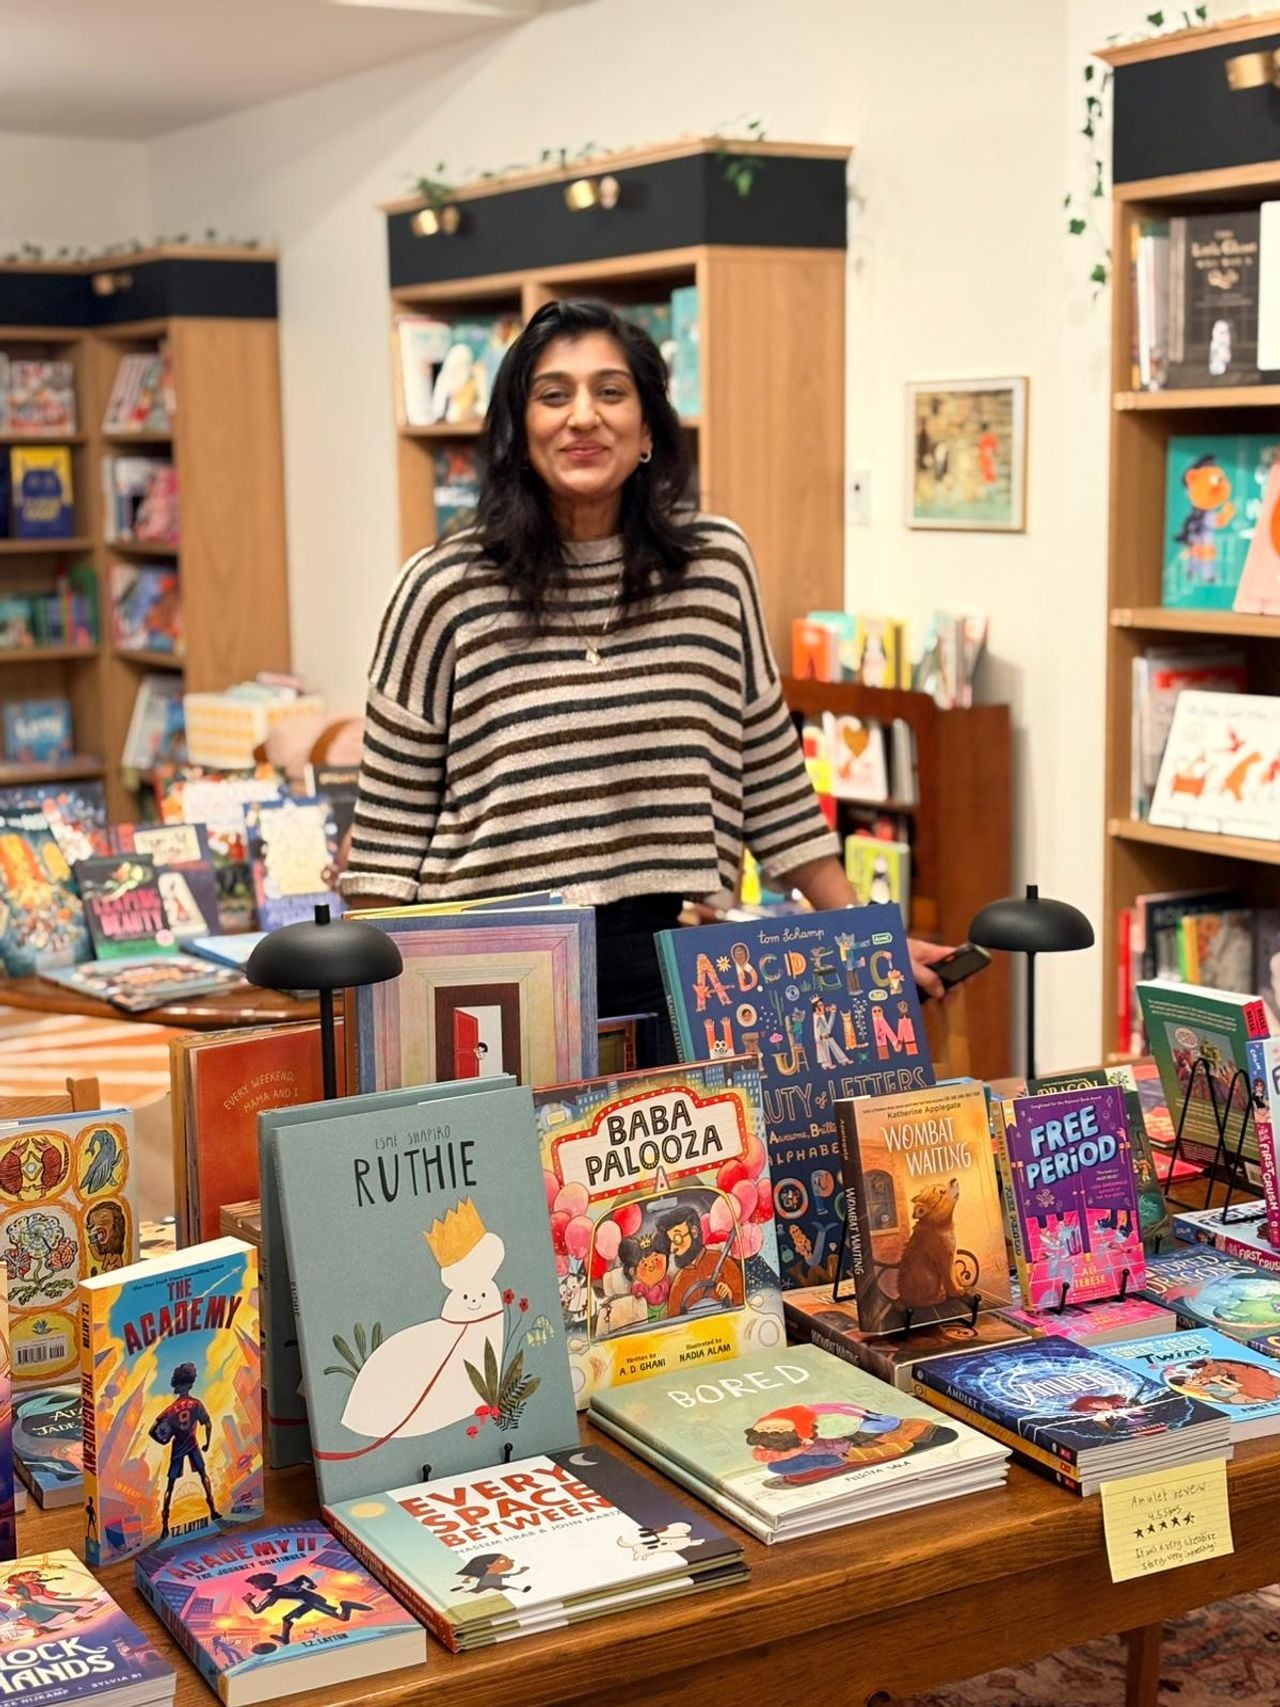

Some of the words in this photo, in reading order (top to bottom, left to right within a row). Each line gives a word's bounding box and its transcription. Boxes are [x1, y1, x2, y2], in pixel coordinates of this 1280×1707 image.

[223, 1084, 250, 1111] EVERY
[243, 1092, 270, 1114] MAMA
[272, 1088, 292, 1100] AND
[887, 1107, 923, 1119] Katherine
[924, 1101, 962, 1115] Applegate
[407, 1125, 451, 1145] SHAPIRO
[607, 1099, 692, 1146] BABA
[880, 1116, 955, 1153] WOMBAT
[1029, 1105, 1099, 1157] FREE
[585, 1124, 724, 1186] PALOOZA
[905, 1141, 972, 1177] WAITING
[1259, 1143, 1275, 1177] FIRST
[354, 1140, 477, 1207] RUTHIE
[1262, 1173, 1279, 1211] CRUSH
[845, 1187, 859, 1232] WOMBAT
[851, 1233, 865, 1275] WAITING
[1239, 1247, 1263, 1262] FIRST
[167, 1277, 193, 1301] THE
[123, 1295, 243, 1356] ACADEMY
[619, 1367, 627, 1377] A
[630, 1364, 636, 1374] D
[639, 1357, 667, 1372] GHANI
[679, 1348, 705, 1363] NADIA
[707, 1343, 731, 1357] ALAM
[1136, 1345, 1211, 1365] Twins
[82, 1371, 93, 1397] THE
[667, 1364, 811, 1409] BORED
[946, 1385, 979, 1410] AMULET
[179, 1410, 190, 1430] 9
[82, 1396, 98, 1476] ACADEMY
[398, 1463, 571, 1517] EVERY
[1131, 1488, 1168, 1508] Amulet
[421, 1481, 599, 1534] SPACE
[438, 1495, 615, 1548] BETWEEN
[551, 1520, 583, 1532] JOHN
[167, 1539, 291, 1580] ACADEMY
[196, 1570, 213, 1581] THE
[217, 1562, 256, 1576] JOURNEY
[259, 1552, 307, 1566] CONTINUES
[316, 1632, 349, 1646] LAYTON
[21, 1689, 70, 1704] NIJKAMP
[91, 1676, 129, 1689] SYLVIA
